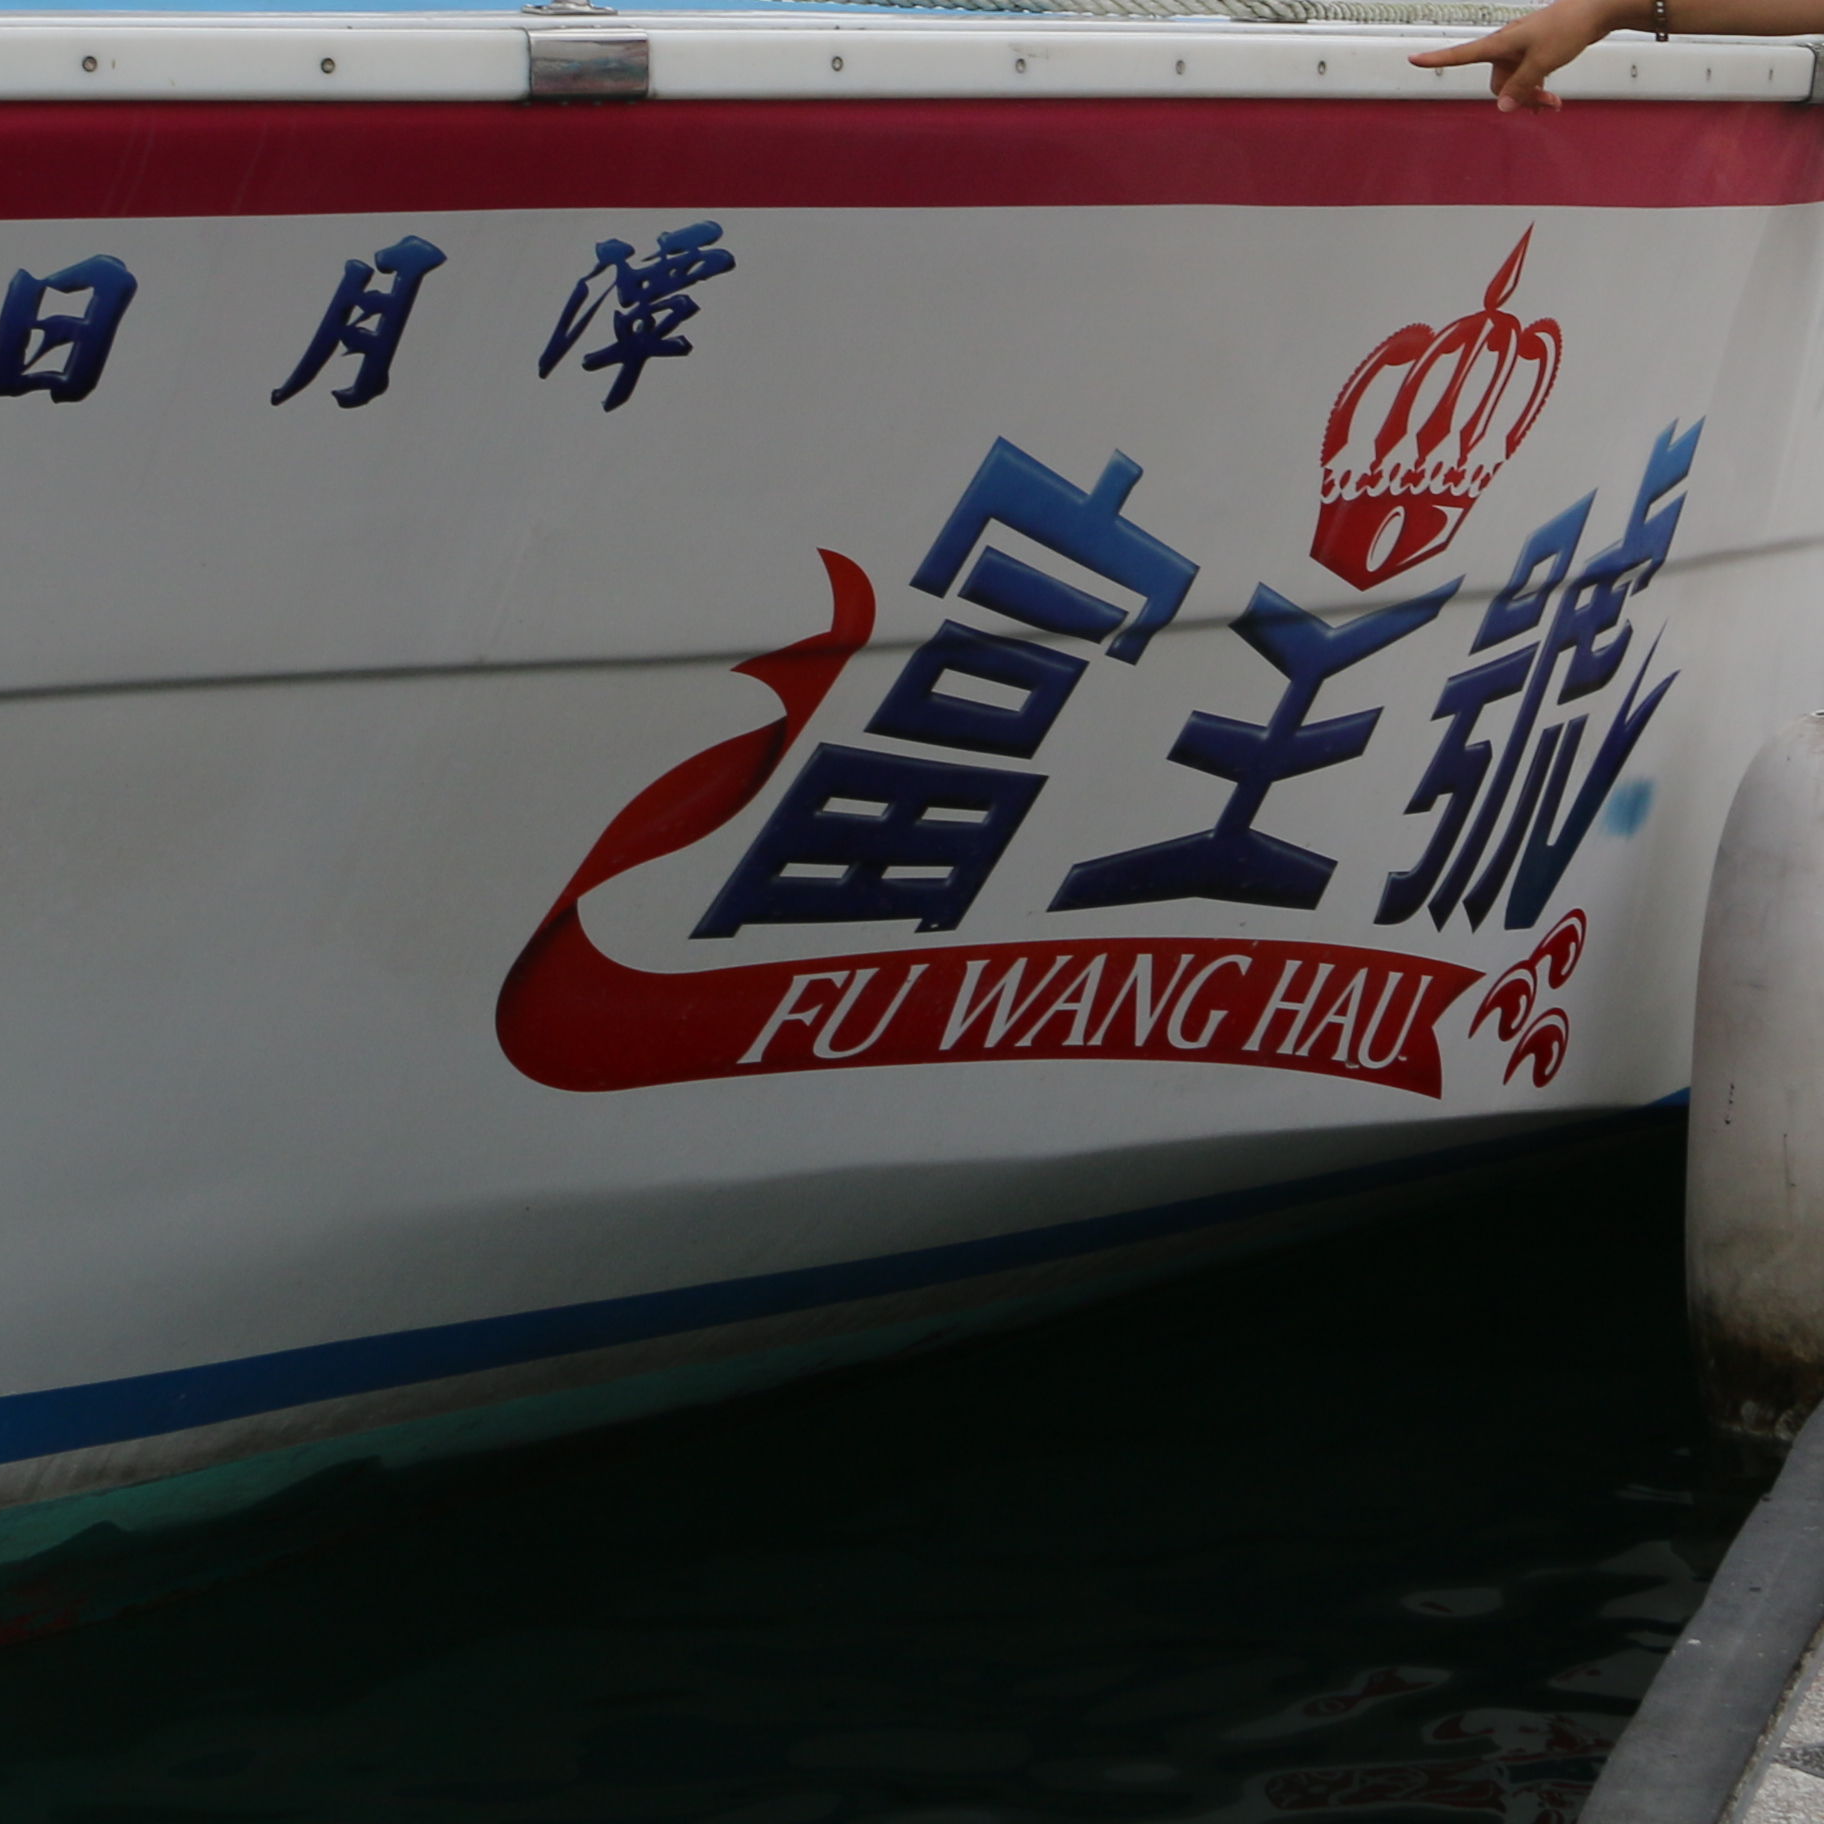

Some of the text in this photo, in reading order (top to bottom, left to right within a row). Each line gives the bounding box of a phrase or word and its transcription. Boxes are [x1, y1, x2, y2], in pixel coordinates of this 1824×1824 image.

[689, 417, 1705, 938] 富王號
[736, 953, 1433, 1070] FU WANG HAU
